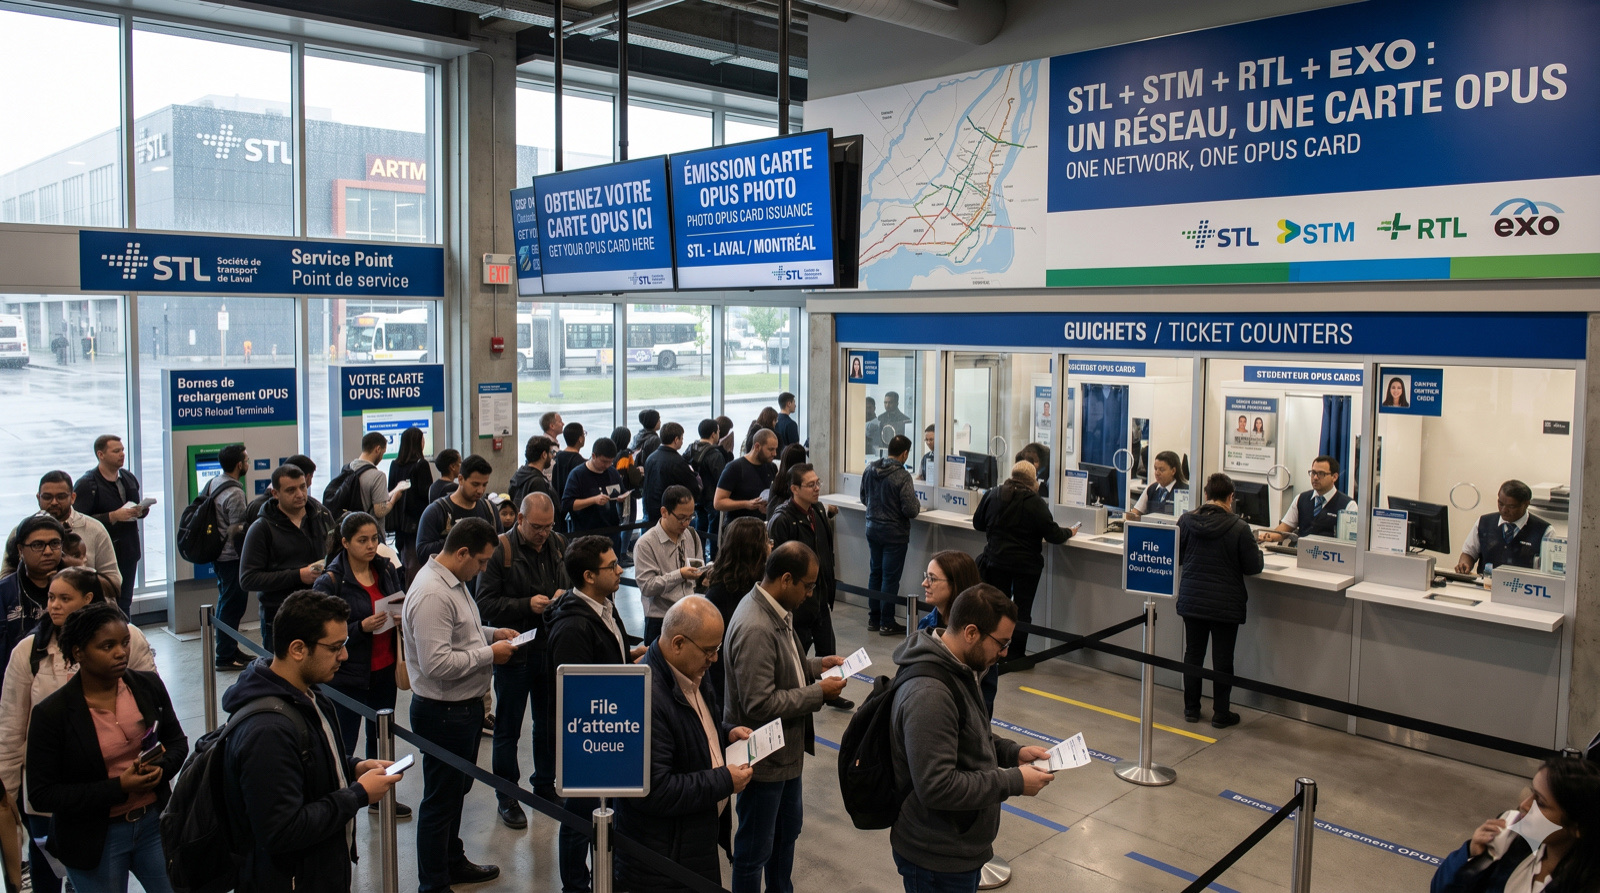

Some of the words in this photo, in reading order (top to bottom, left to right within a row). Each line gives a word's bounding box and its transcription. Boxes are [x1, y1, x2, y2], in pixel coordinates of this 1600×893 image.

[1067, 82, 1113, 114] STL
[1119, 85, 1135, 104] +
[1142, 68, 1203, 104] STM
[1211, 71, 1229, 92] +
[1238, 56, 1293, 91] RTL
[1301, 58, 1321, 80] +
[1330, 38, 1416, 79] EXO
[1067, 121, 1105, 153] UN
[1114, 105, 1237, 148] RÉSEAU,
[1246, 94, 1314, 133] UNE
[1324, 78, 1443, 125] CARTE
[1455, 63, 1568, 110] OPUS
[146, 133, 165, 162] STL
[244, 138, 292, 165] STL
[1066, 159, 1099, 180] ONE
[1104, 150, 1195, 177] NETWORK,
[1200, 145, 1238, 168] ONE
[1244, 139, 1298, 164] OPUS
[1304, 133, 1361, 158] CARD
[370, 158, 426, 181] ARTM
[684, 159, 756, 185] ÉMISSION
[760, 147, 813, 175] CARTE
[544, 186, 603, 214] OBTENEZ
[604, 179, 652, 207] VOTRE
[700, 183, 739, 208] OPUS
[743, 176, 797, 203] PHOTO
[547, 214, 588, 239] CARTE
[590, 209, 629, 235] OPUS
[632, 207, 653, 231] ICI
[687, 213, 714, 227] PHOTO
[715, 210, 738, 225] OPUS
[740, 207, 764, 222] CARD
[765, 202, 813, 220] ISSUANCE
[529, 227, 538, 239] YO
[1303, 221, 1355, 245] STM
[1417, 217, 1467, 240] RTL
[1494, 215, 1560, 237] exo
[687, 243, 705, 258] STL
[713, 240, 745, 257] LAVAL
[747, 239, 752, 256] /
[753, 233, 816, 254] MONTRÉAL
[1217, 227, 1259, 248] STL
[549, 244, 562, 258] GET
[562, 242, 584, 257] YOUR
[584, 240, 607, 255] OPUS
[607, 238, 630, 253] CARD
[631, 236, 655, 251] HERE
[217, 257, 249, 265] Société
[250, 257, 262, 266] de
[291, 248, 350, 266] Service
[354, 251, 394, 268] Point
[153, 255, 211, 282] STL
[217, 266, 258, 275] transport
[488, 265, 510, 283] EXIT
[785, 270, 803, 281] STL
[230, 275, 253, 283] Laval
[292, 270, 331, 286] Point
[335, 271, 353, 287] de
[357, 273, 409, 288] service
[638, 275, 652, 285] STL
[1064, 321, 1147, 341] GUICHETS
[1153, 322, 1162, 344] /
[1168, 322, 1235, 343] TICKET
[1240, 322, 1353, 345] COUNTERS
[1097, 364, 1115, 372] OPUS
[1115, 365, 1136, 373] CARDS
[1310, 372, 1332, 381] OPUS
[1333, 373, 1361, 382] CARDS
[177, 378, 218, 389] Bornes
[220, 377, 235, 388] de
[348, 373, 386, 386] VOTRE
[388, 372, 424, 385] CARTE
[178, 390, 256, 404] rechargement
[258, 388, 289, 400] OPUS
[349, 388, 384, 400] OPUS:
[387, 386, 421, 399] INFOS
[178, 407, 203, 418] OPUS
[205, 406, 234, 417] Reload
[235, 405, 275, 416] Terminals
[952, 496, 967, 506] STL
[1142, 541, 1159, 552] File
[1129, 551, 1172, 565] d'attente
[1322, 550, 1345, 563] STL
[1523, 583, 1551, 599] STL
[590, 699, 618, 715] File
[567, 718, 640, 734] d'attente
[582, 739, 625, 753] Queue
[1232, 794, 1273, 812] Bornes
